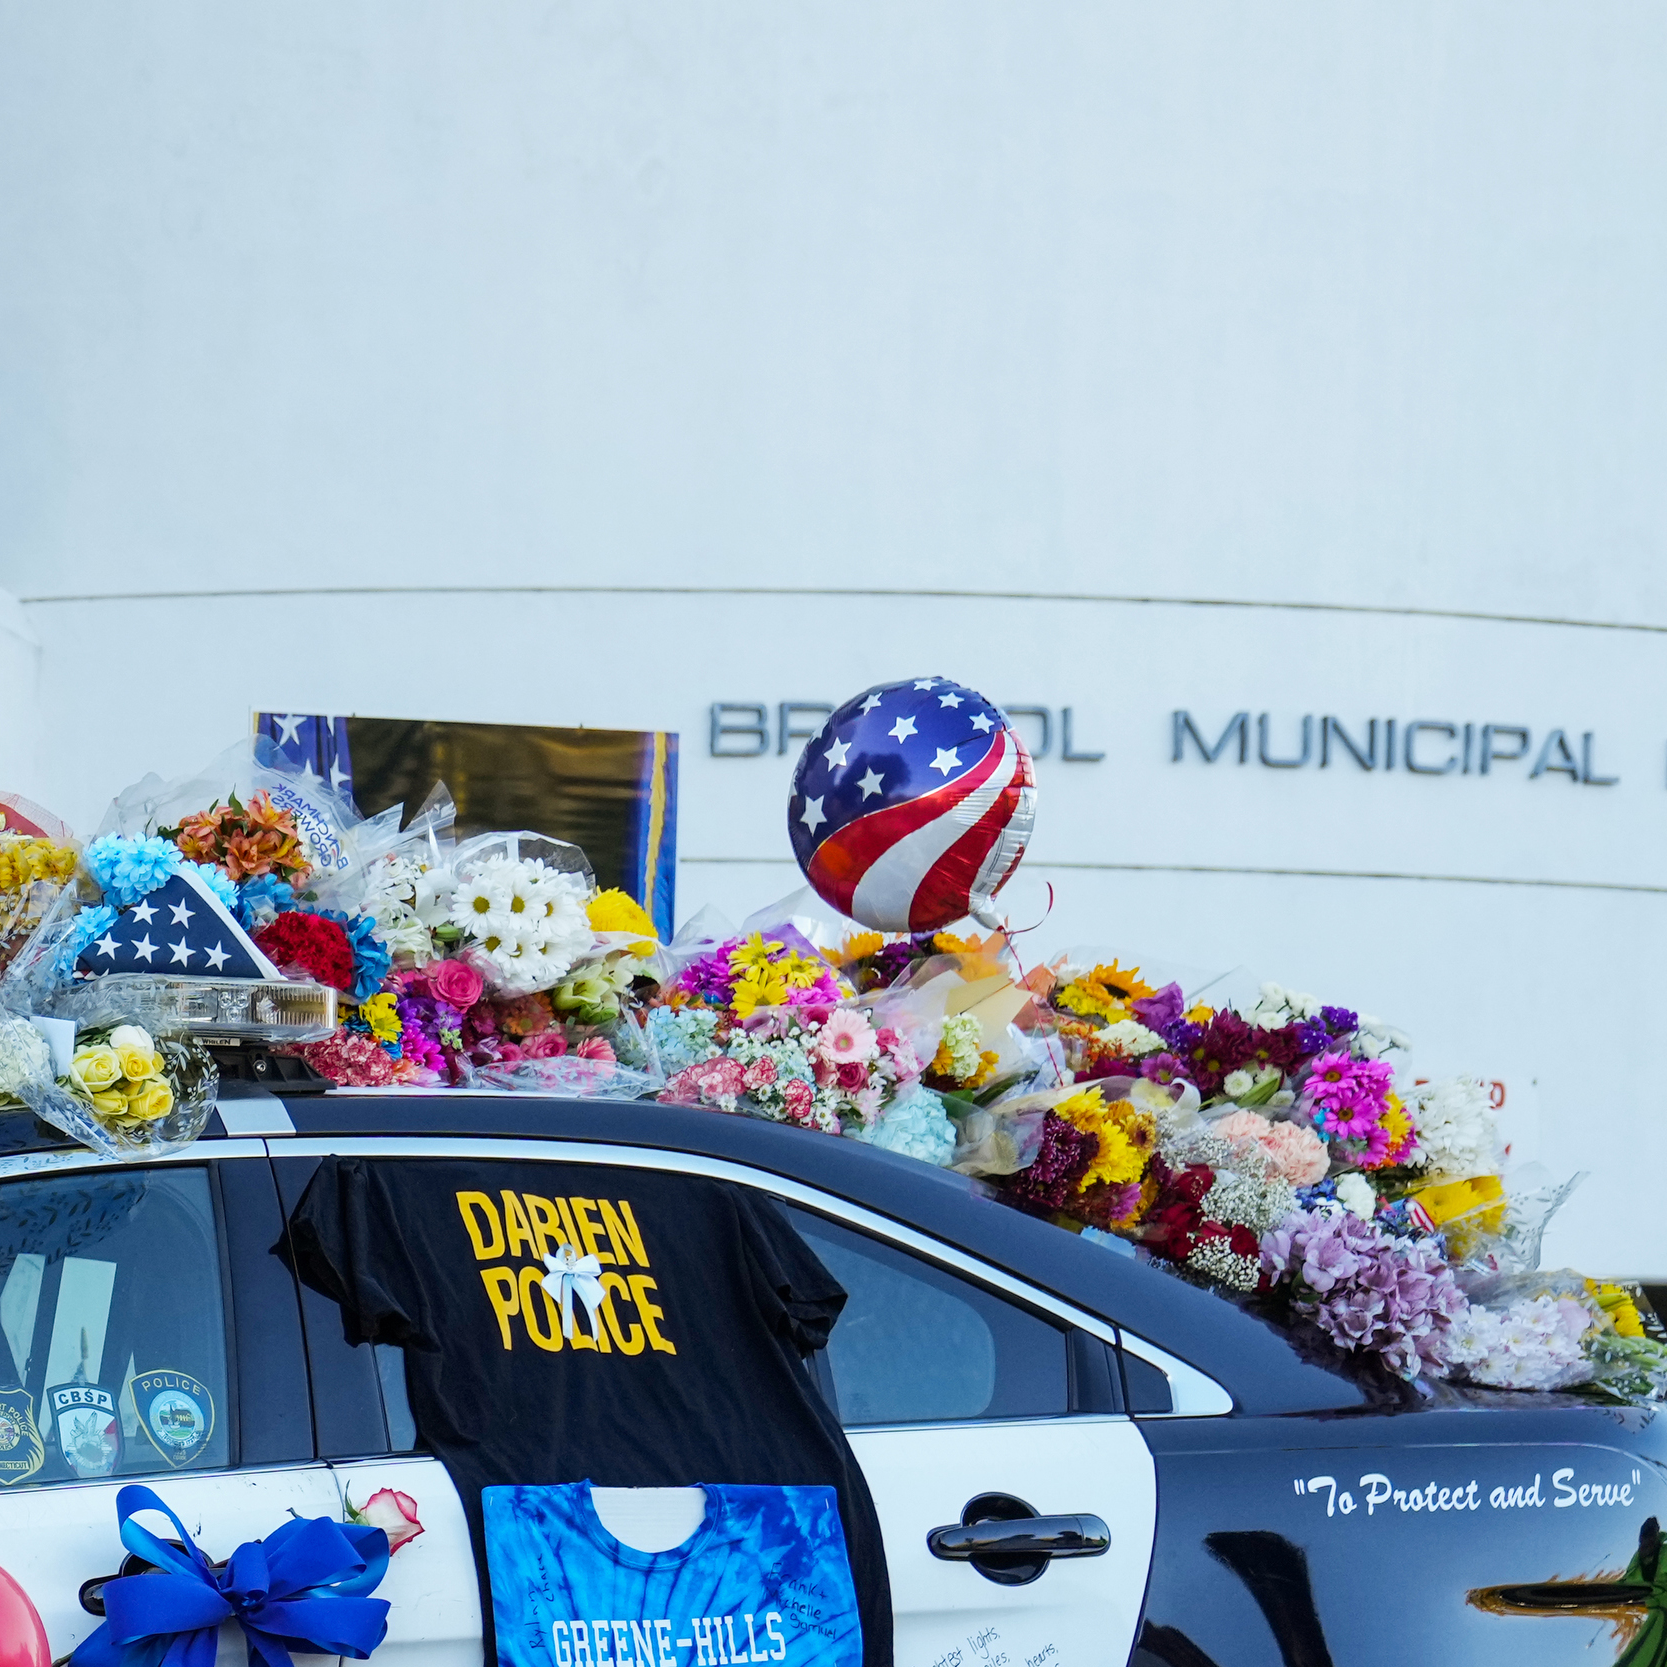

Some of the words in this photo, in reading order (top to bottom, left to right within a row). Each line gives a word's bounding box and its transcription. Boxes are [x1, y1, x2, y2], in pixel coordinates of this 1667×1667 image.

[708, 701, 1106, 763] BROL
[1173, 708, 1620, 788] MUNICIPAL
[455, 1189, 652, 1268] DARIEN
[142, 1377, 201, 1396] POLICE
[7, 1407, 29, 1437] POLICE
[1358, 1472, 1482, 1516] Protect
[1489, 1475, 1546, 1509] and
